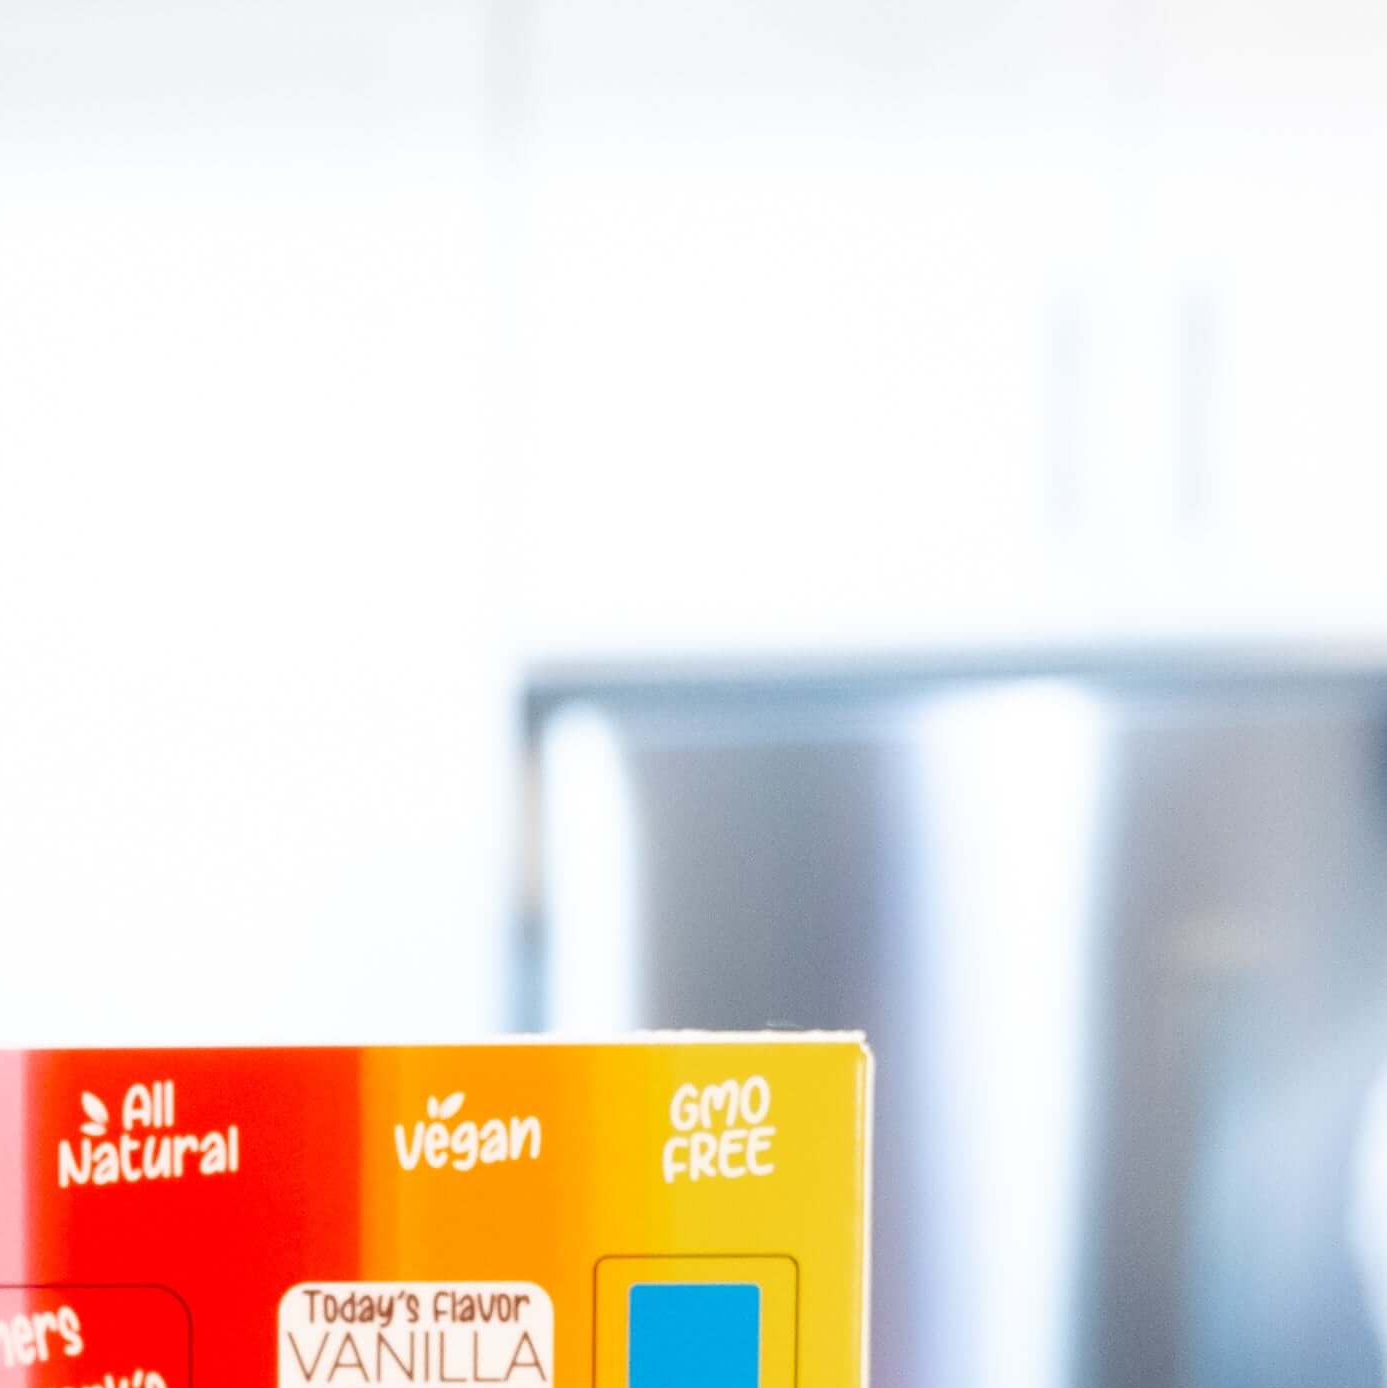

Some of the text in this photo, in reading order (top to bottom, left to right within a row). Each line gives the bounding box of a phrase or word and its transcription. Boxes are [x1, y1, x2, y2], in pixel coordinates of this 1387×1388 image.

[123, 1080, 175, 1131] All
[670, 1075, 771, 1131] GMO
[59, 1125, 239, 1188] Natural
[395, 1113, 541, 1171] Vegan
[662, 1126, 776, 1184] FREE
[303, 1290, 419, 1327] Today's
[288, 1331, 547, 1382] VANILLA
